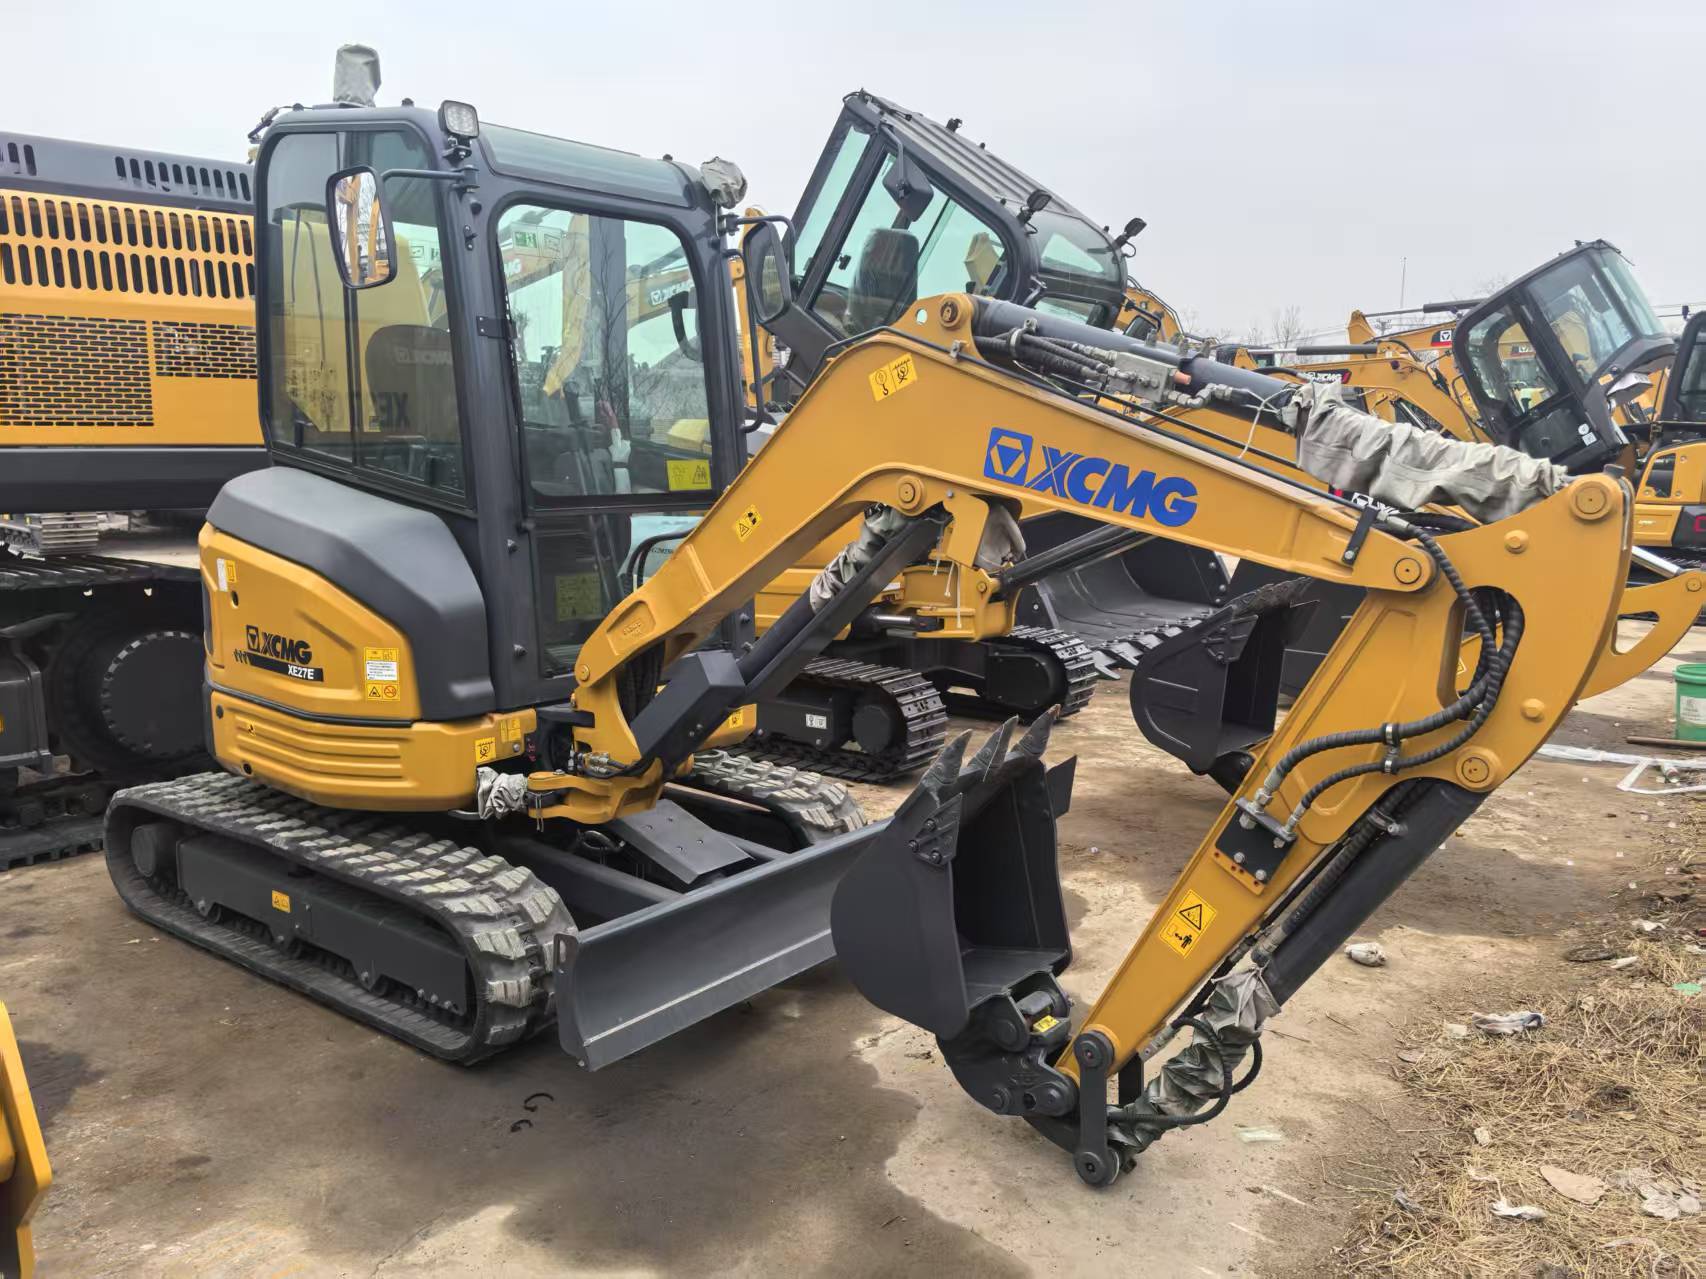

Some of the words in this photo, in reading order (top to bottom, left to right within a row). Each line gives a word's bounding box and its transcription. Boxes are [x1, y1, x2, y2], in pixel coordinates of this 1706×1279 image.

[1025, 444, 1198, 527] XCMG
[260, 632, 312, 664] XCMG
[288, 664, 314, 679] XE27E
